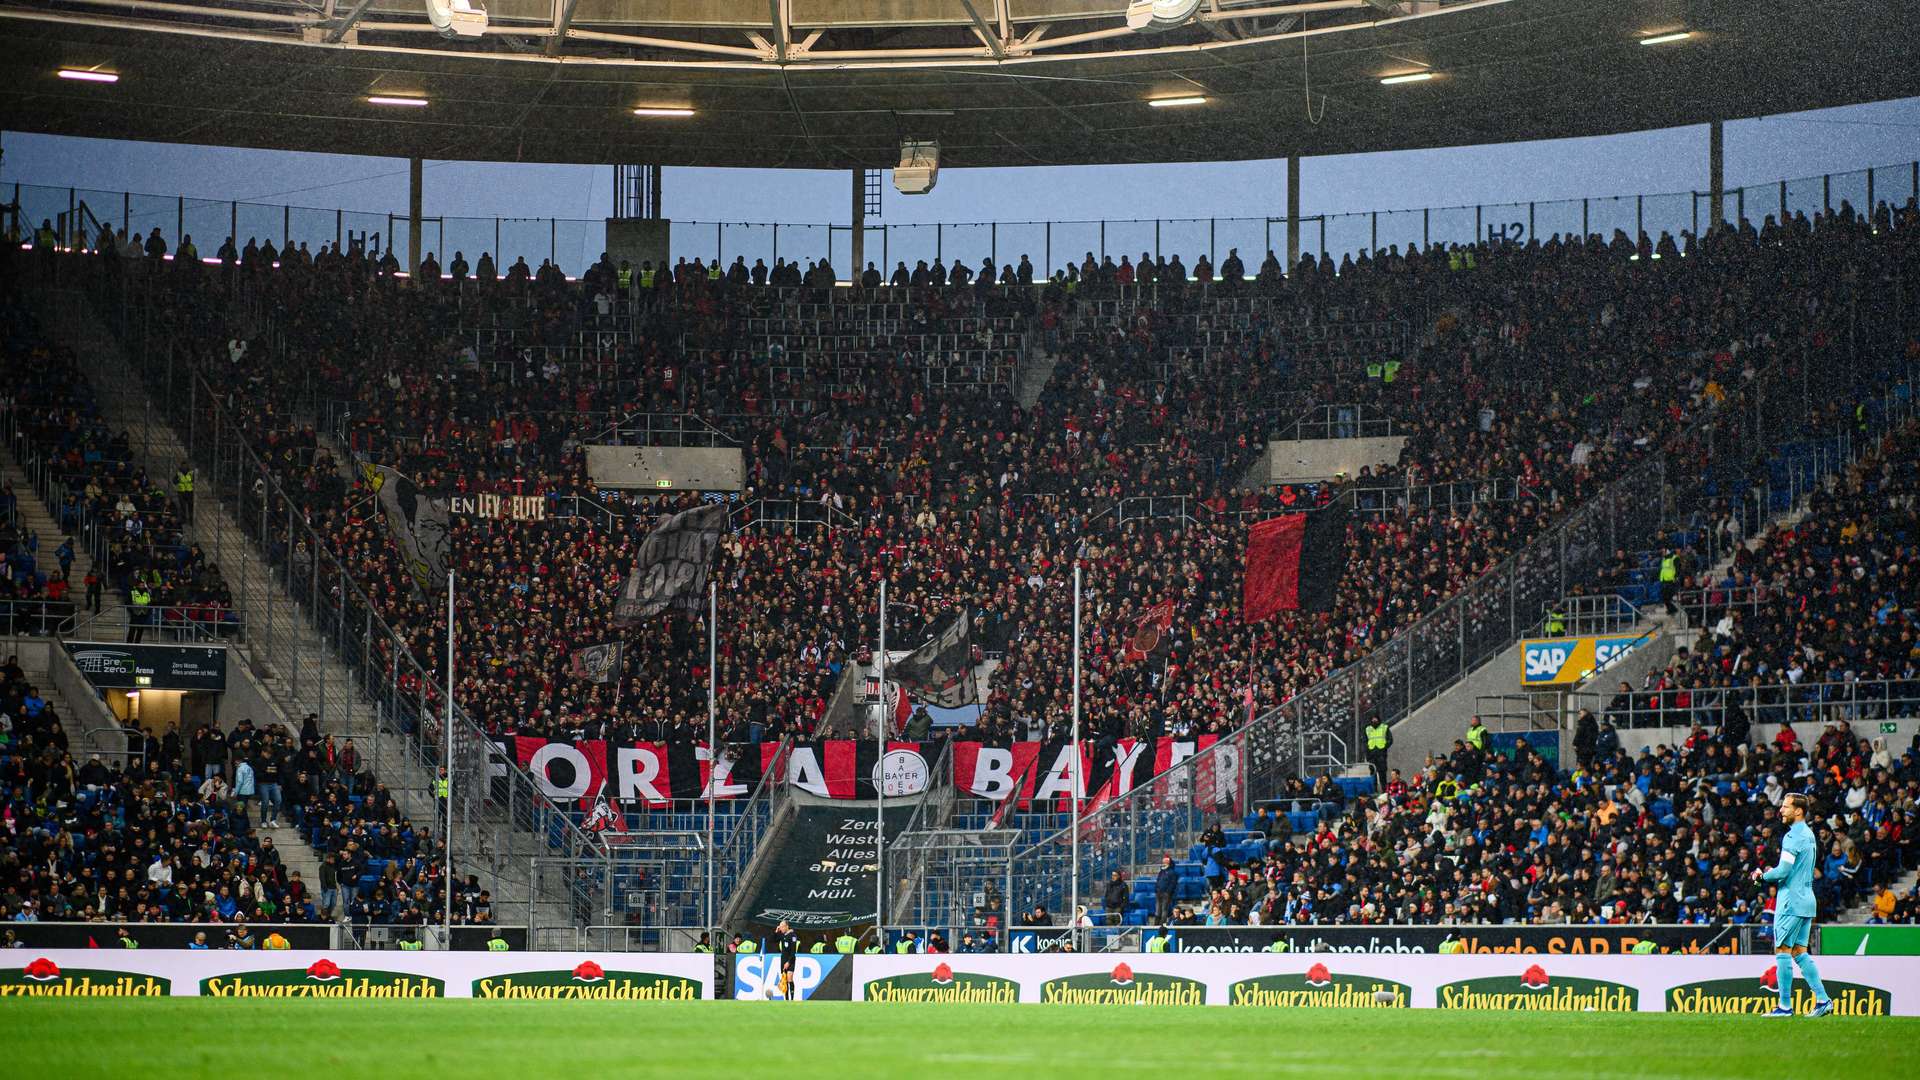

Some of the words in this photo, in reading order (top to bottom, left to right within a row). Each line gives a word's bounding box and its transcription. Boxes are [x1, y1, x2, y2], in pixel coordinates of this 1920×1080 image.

[348, 230, 380, 256] H1
[1488, 222, 1524, 247] H2
[513, 495, 546, 521] ELITE
[103, 658, 121, 667] pre
[103, 666, 127, 674] zero
[1526, 648, 1566, 676] SAP
[485, 741, 829, 803] FORZA
[884, 772, 919, 781] BAYER
[971, 741, 1242, 804] BAYER
[826, 849, 876, 859] Alles
[827, 877, 852, 886] ist
[808, 889, 857, 899] Müll.
[207, 978, 436, 998] Schwarzwaldmilch
[478, 979, 695, 1000] Schwarzwaldmilch
[736, 956, 822, 1001] SAP
[868, 981, 1015, 1004] Schwarzwaldmilch
[1044, 981, 1201, 1006] Schwarzwaldmilch
[1442, 986, 1634, 1013] Schwarzwaldmilch
